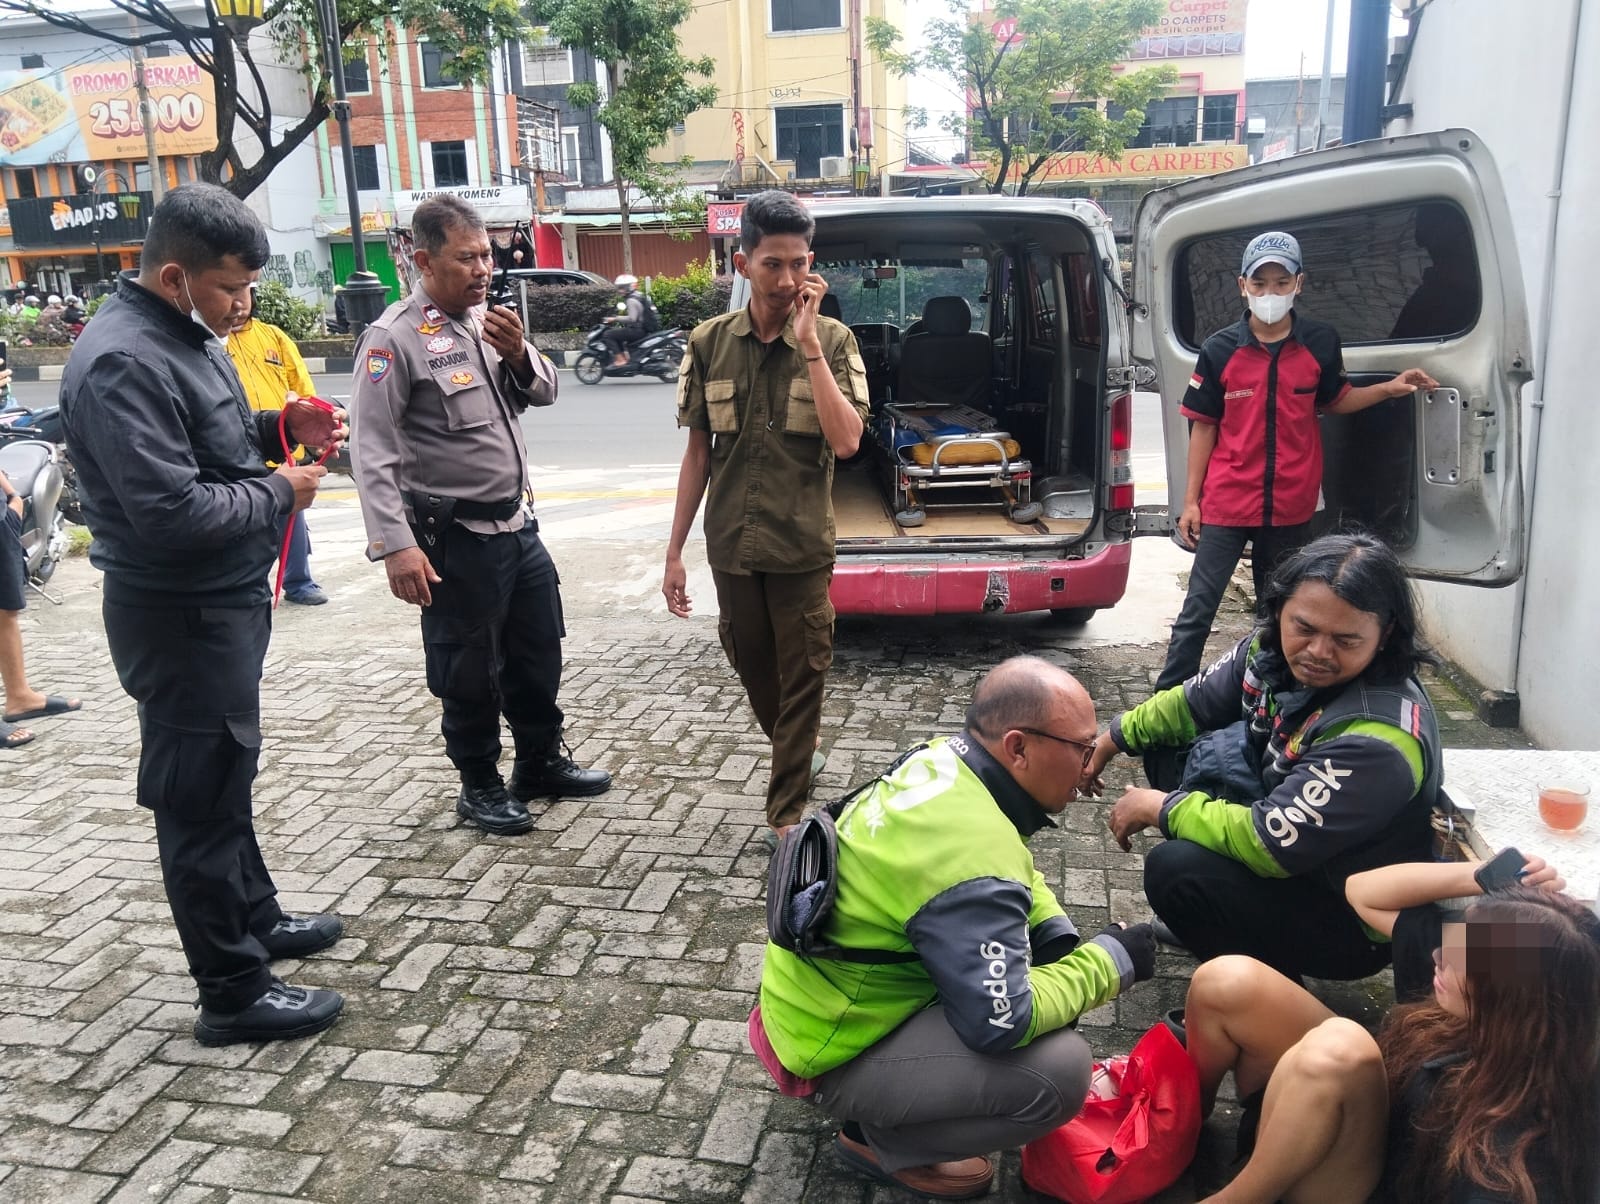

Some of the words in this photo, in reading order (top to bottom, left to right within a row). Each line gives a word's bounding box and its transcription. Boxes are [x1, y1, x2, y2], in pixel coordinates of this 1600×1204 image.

[1163, 26, 1181, 34] Silk
[1172, 14, 1226, 25] CARPETS
[72, 71, 130, 95] PROMO
[134, 62, 201, 88] ERKAH
[89, 93, 204, 138] 25.000
[1130, 151, 1235, 173] CARPETS
[457, 188, 501, 200] KOMENG
[1264, 758, 1353, 848] gojek
[979, 940, 1015, 1030] gopay
